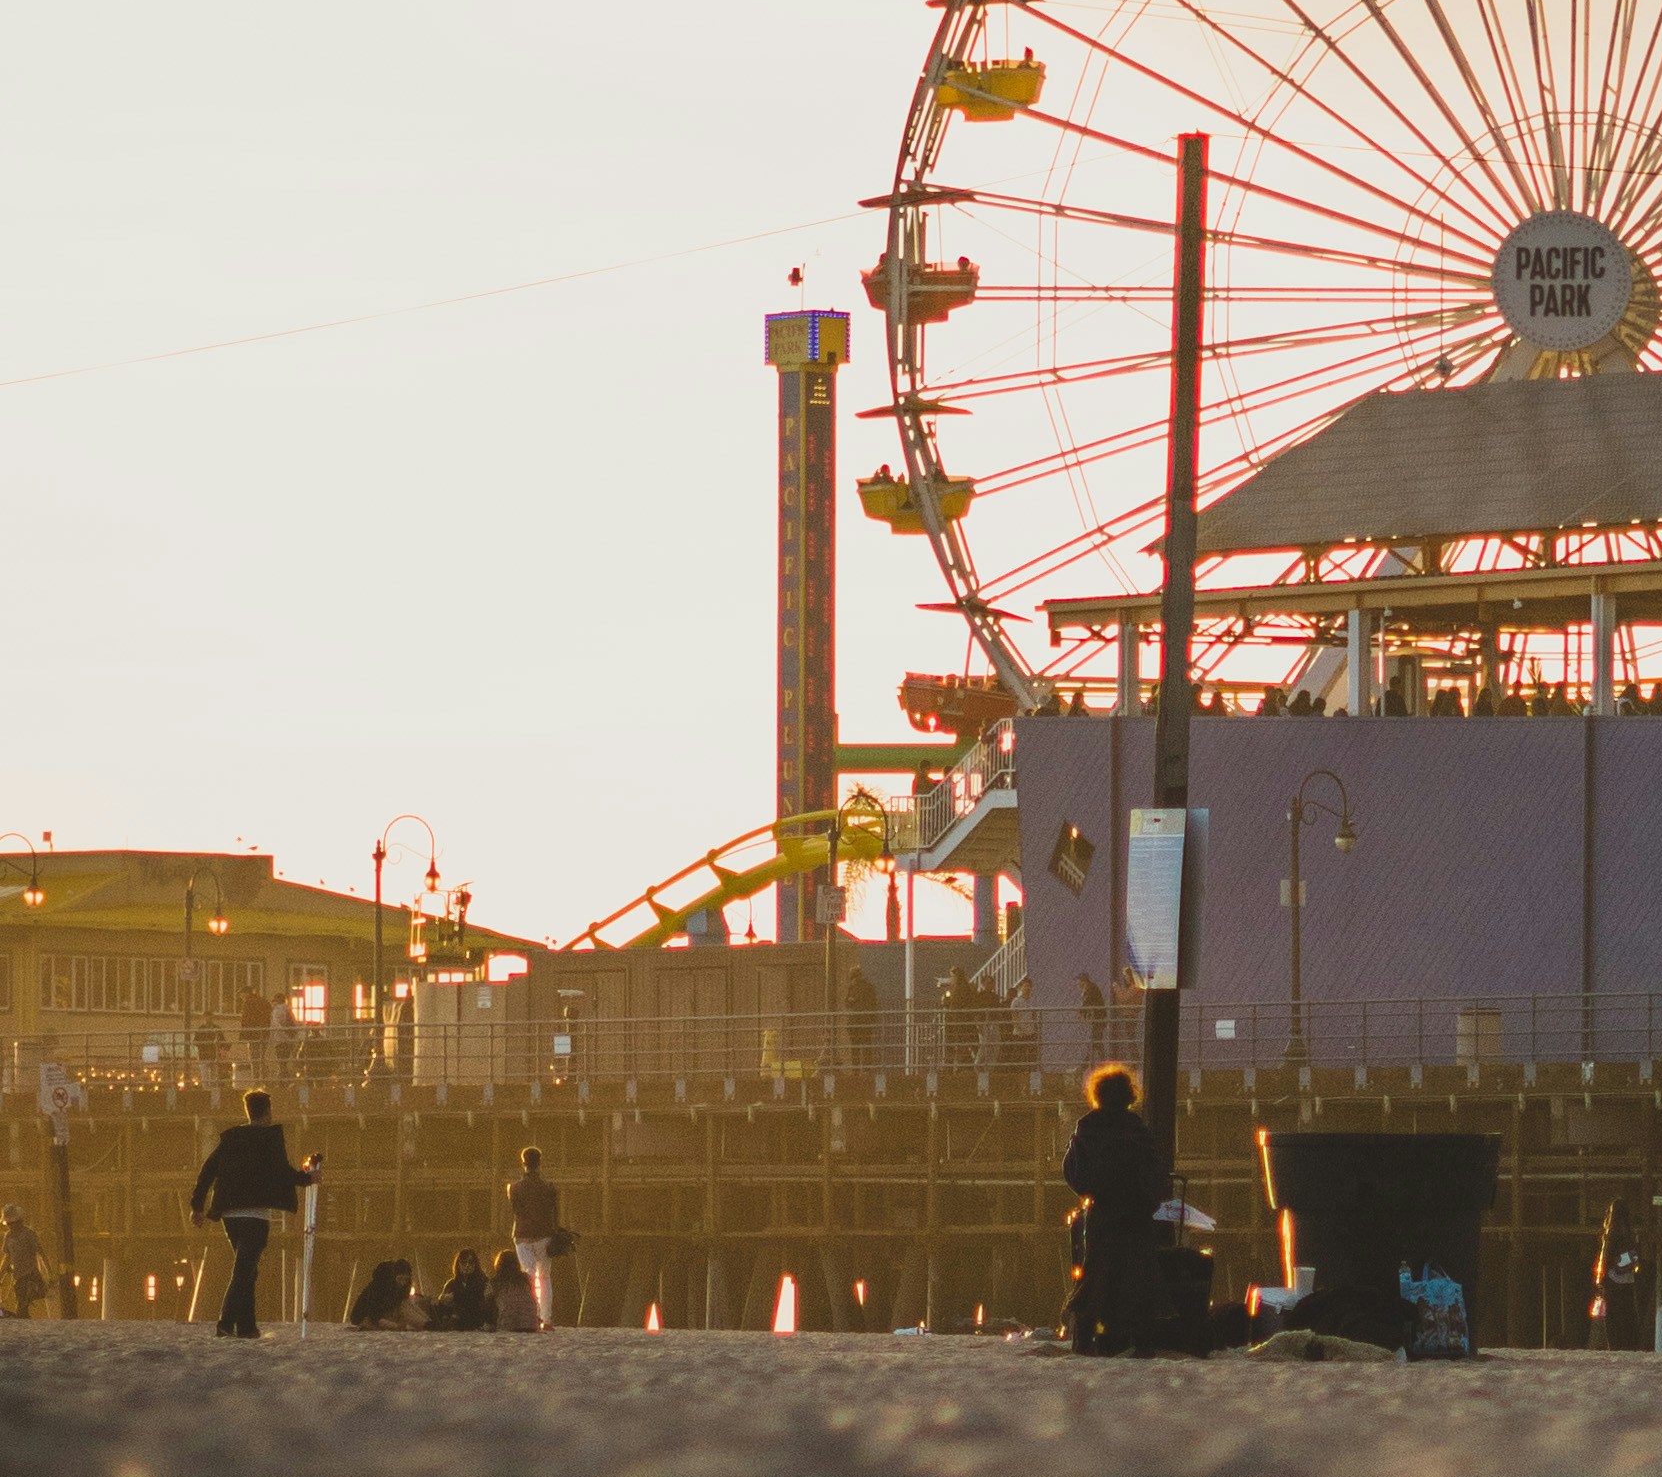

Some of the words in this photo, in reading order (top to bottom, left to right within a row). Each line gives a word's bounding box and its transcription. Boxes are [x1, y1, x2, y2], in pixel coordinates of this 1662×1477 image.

[1515, 246, 1605, 280] PACIFIC
[1529, 284, 1592, 317] PARK
[782, 417, 797, 648] PACIFIC
